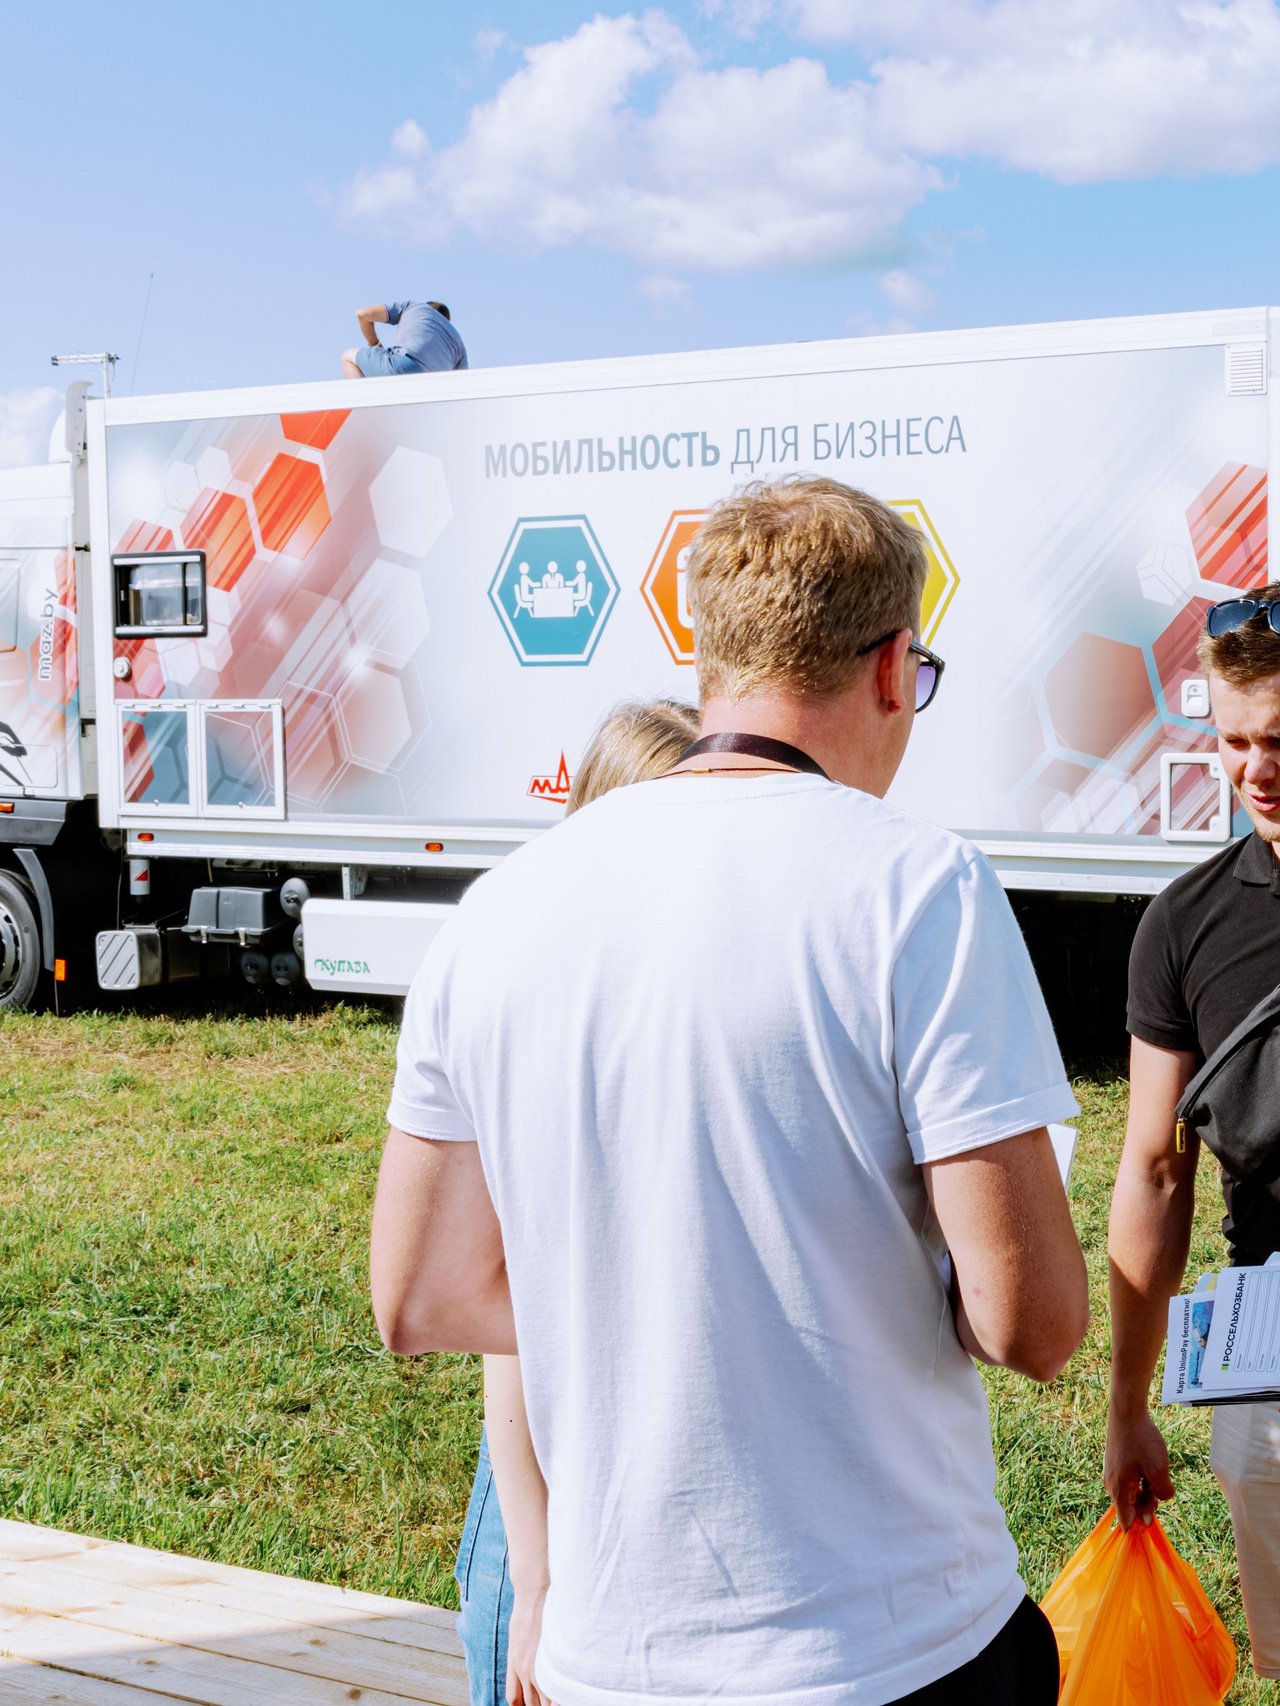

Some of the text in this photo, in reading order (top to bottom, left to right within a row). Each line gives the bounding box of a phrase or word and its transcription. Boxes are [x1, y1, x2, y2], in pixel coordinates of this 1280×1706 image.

[484, 415, 967, 479] МОБИЛЬНОСТЬ ДЛЯ БИЗНЕСА
[39, 587, 59, 680] maz.by
[1176, 1298, 1191, 1394] Карта UnionPay бесплатно!
[1223, 1272, 1247, 1362] РОССЕЛЬХОЗБАНК
